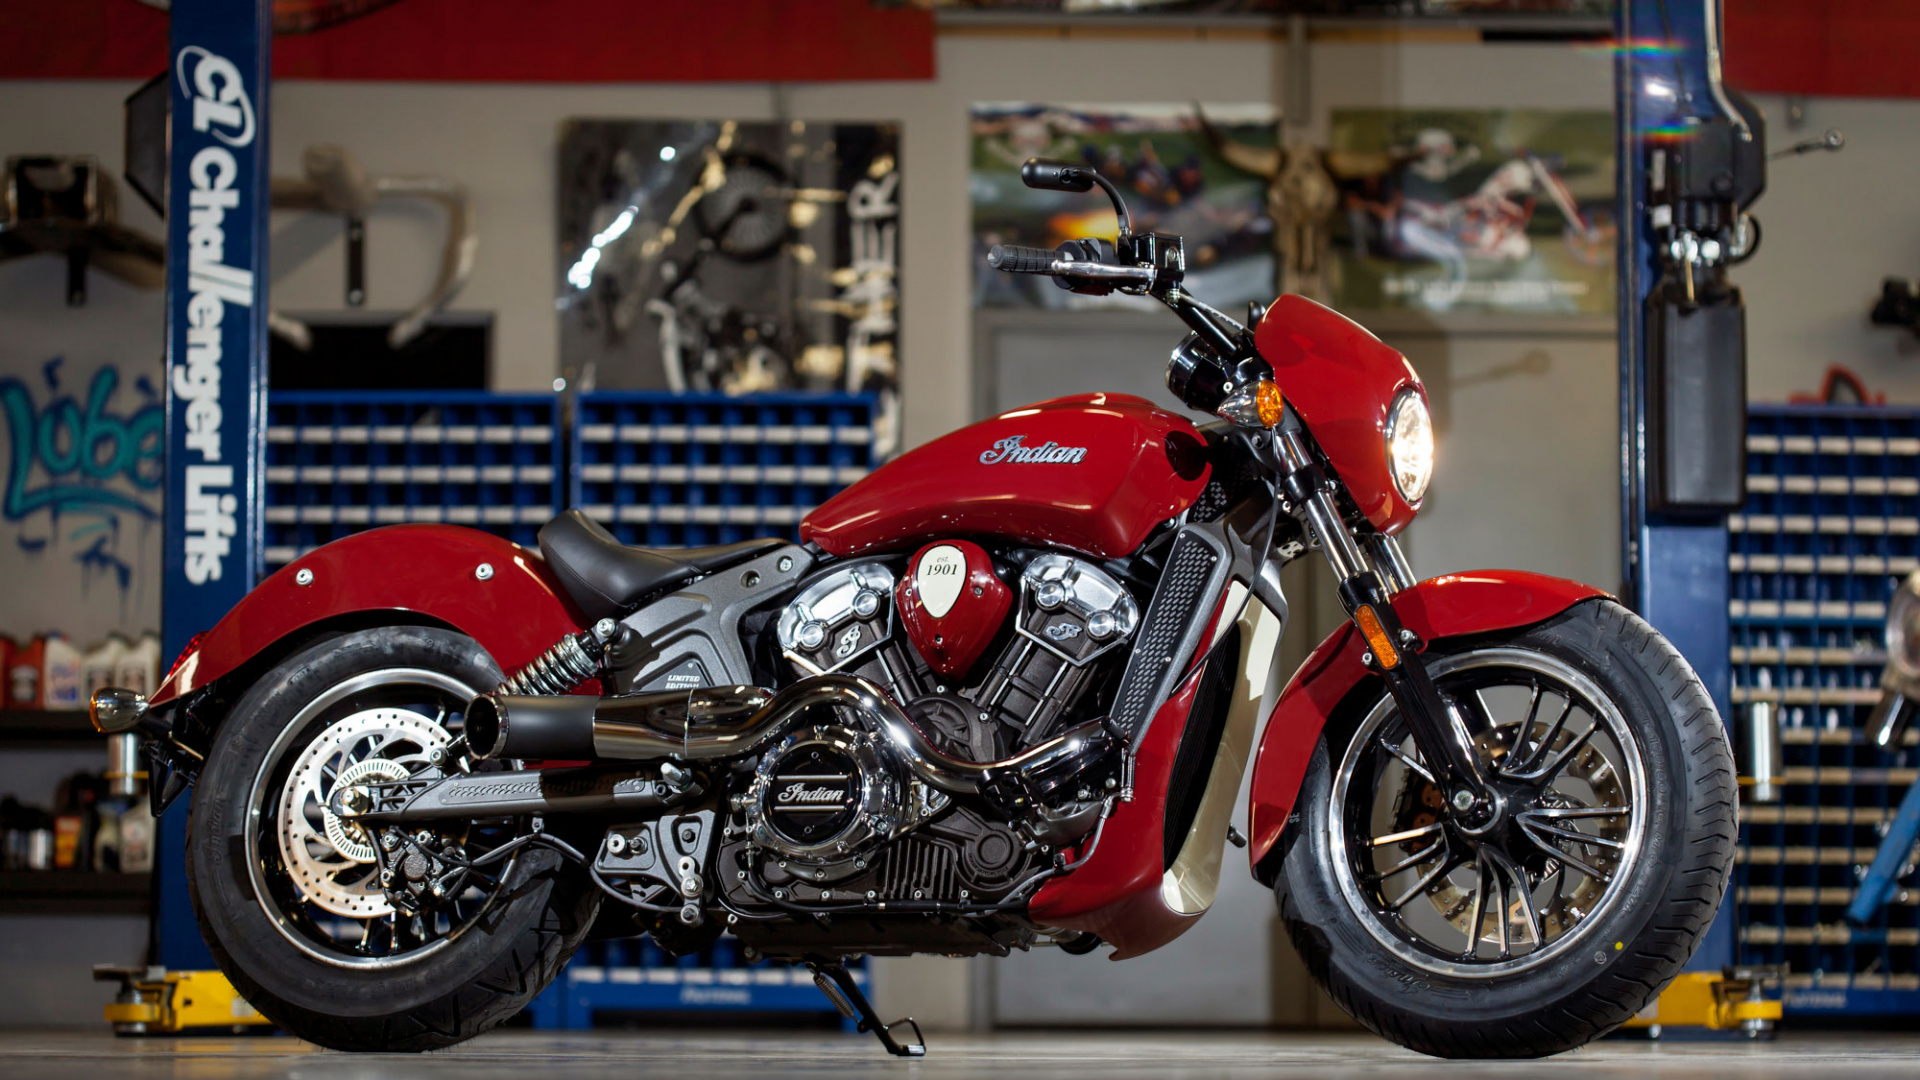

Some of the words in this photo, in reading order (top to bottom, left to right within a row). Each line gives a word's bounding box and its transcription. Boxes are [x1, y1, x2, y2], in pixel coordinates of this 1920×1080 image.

[173, 146, 254, 462] Challenger
[979, 434, 1087, 465] Indian
[184, 465, 238, 585] Lifts
[926, 564, 957, 576] 1901
[665, 682, 700, 690] EDITION
[667, 674, 700, 682] LIMITED
[777, 782, 845, 803] Indian
